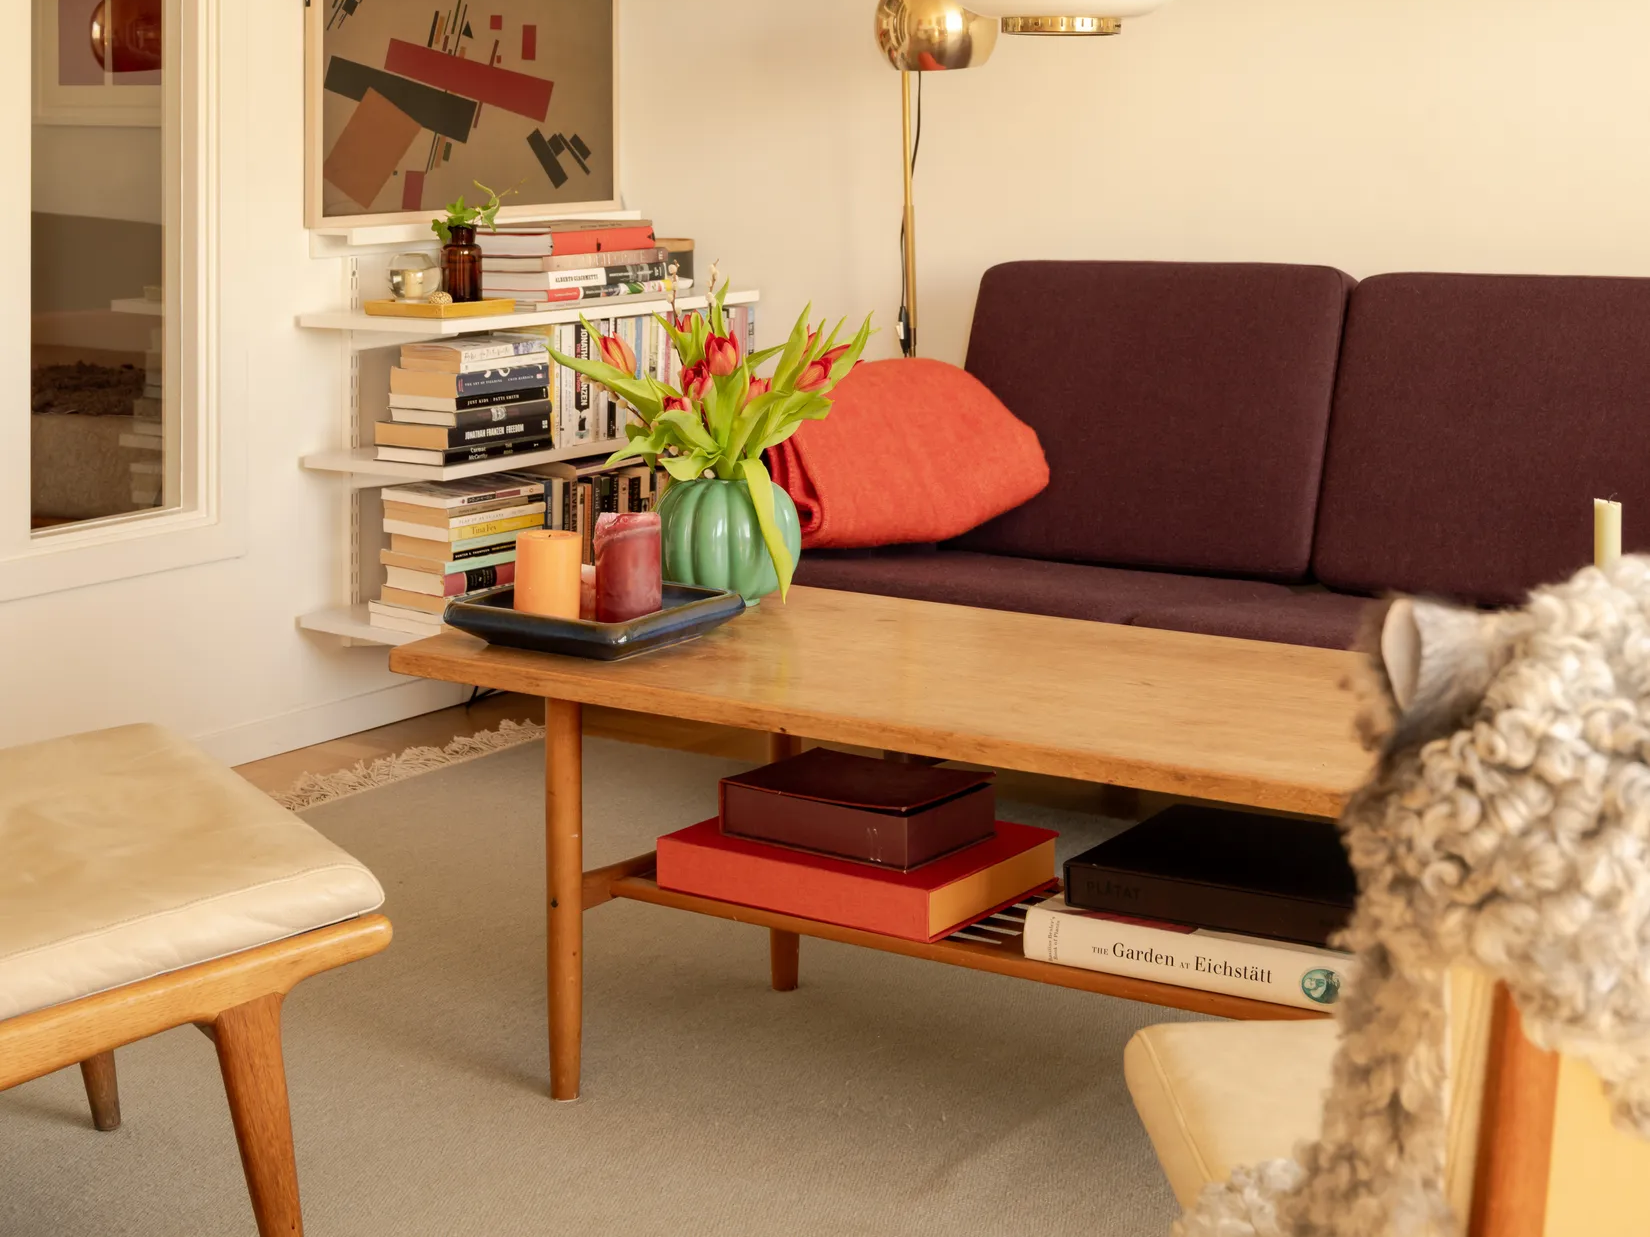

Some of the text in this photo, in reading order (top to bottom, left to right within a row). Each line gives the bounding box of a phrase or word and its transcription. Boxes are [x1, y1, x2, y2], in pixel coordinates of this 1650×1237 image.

[554, 273, 599, 284] ALBERTO GIACOMETTI
[465, 424, 524, 440] JONATHAN FRANZEN FREEDOM
[471, 525, 496, 535] Tina Fey
[1091, 941, 1273, 984] THE Garden AT Eichstätt
